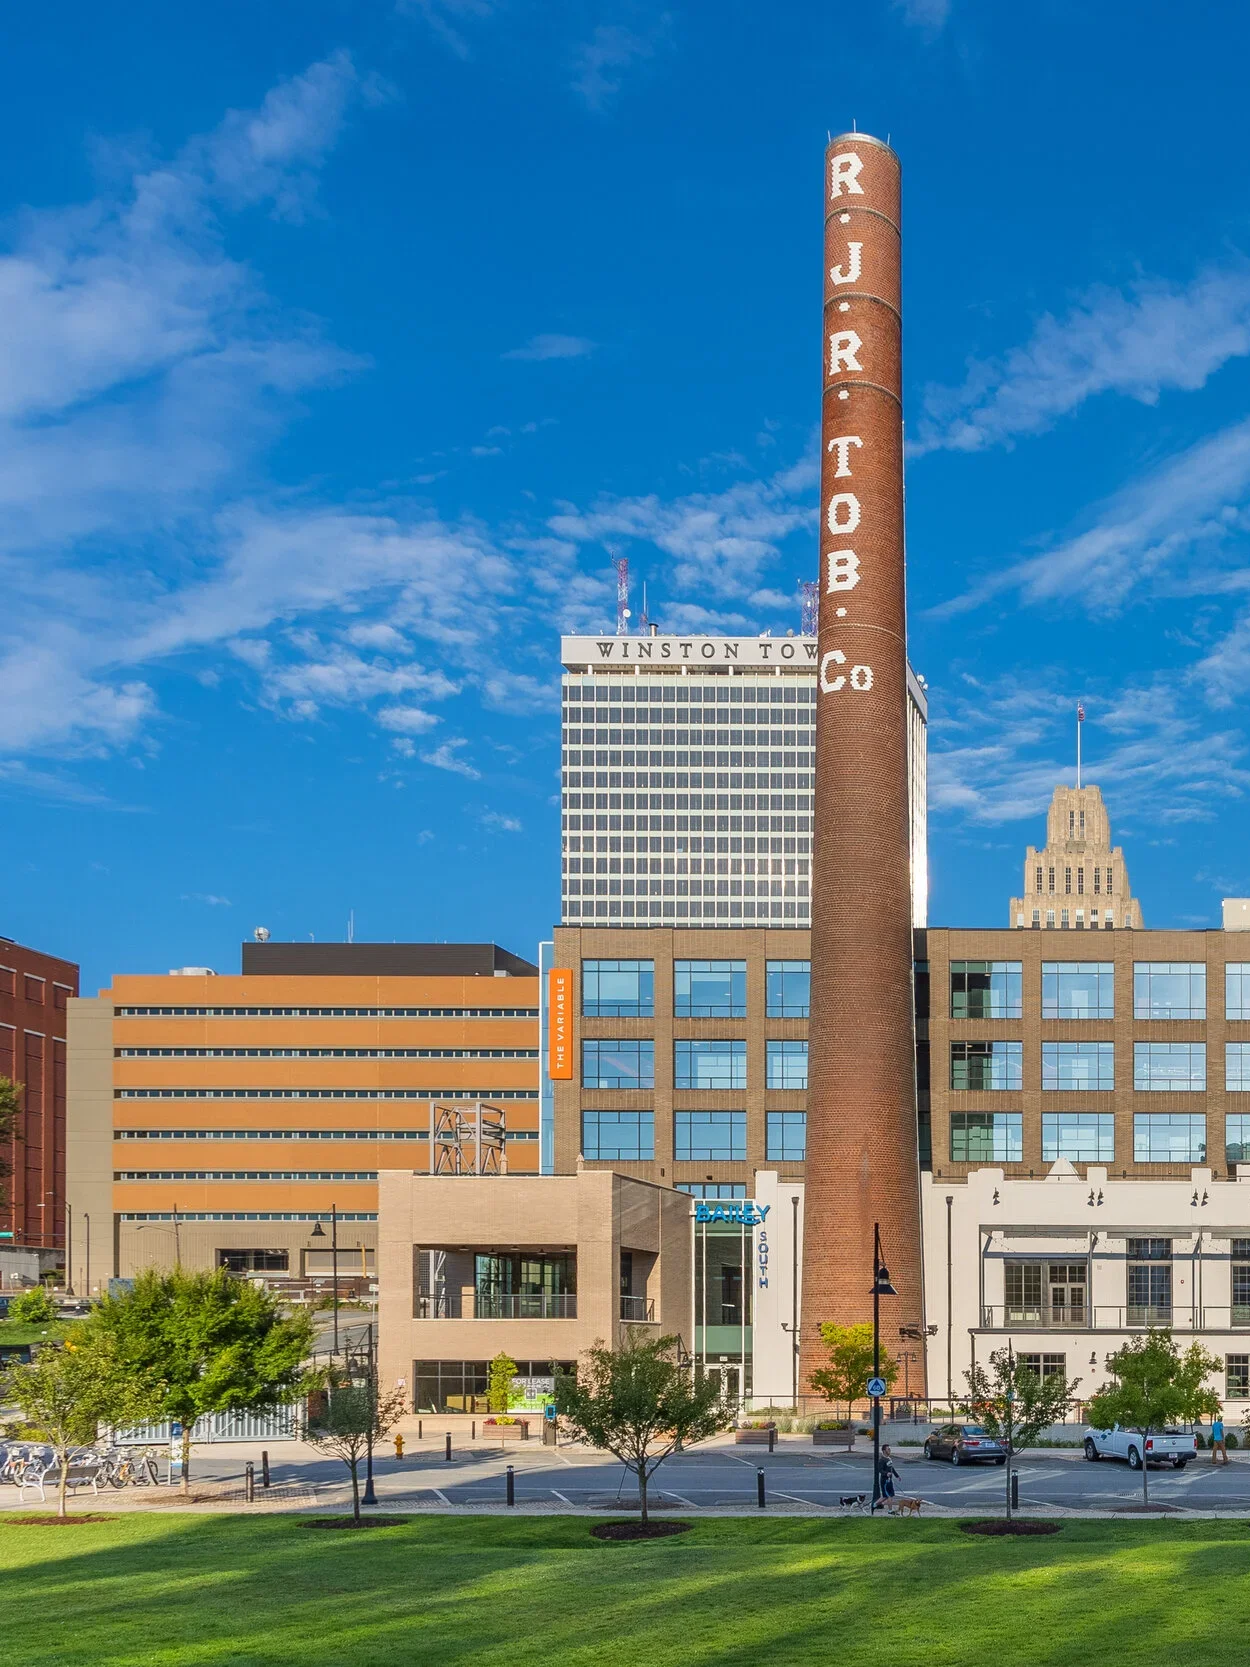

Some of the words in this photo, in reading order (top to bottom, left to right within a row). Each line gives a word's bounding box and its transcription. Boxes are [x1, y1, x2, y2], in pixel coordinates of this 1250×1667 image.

[596, 642, 740, 660] WINSTON
[696, 1204, 771, 1226] BAILEY
[758, 1231, 769, 1288] SOUTH
